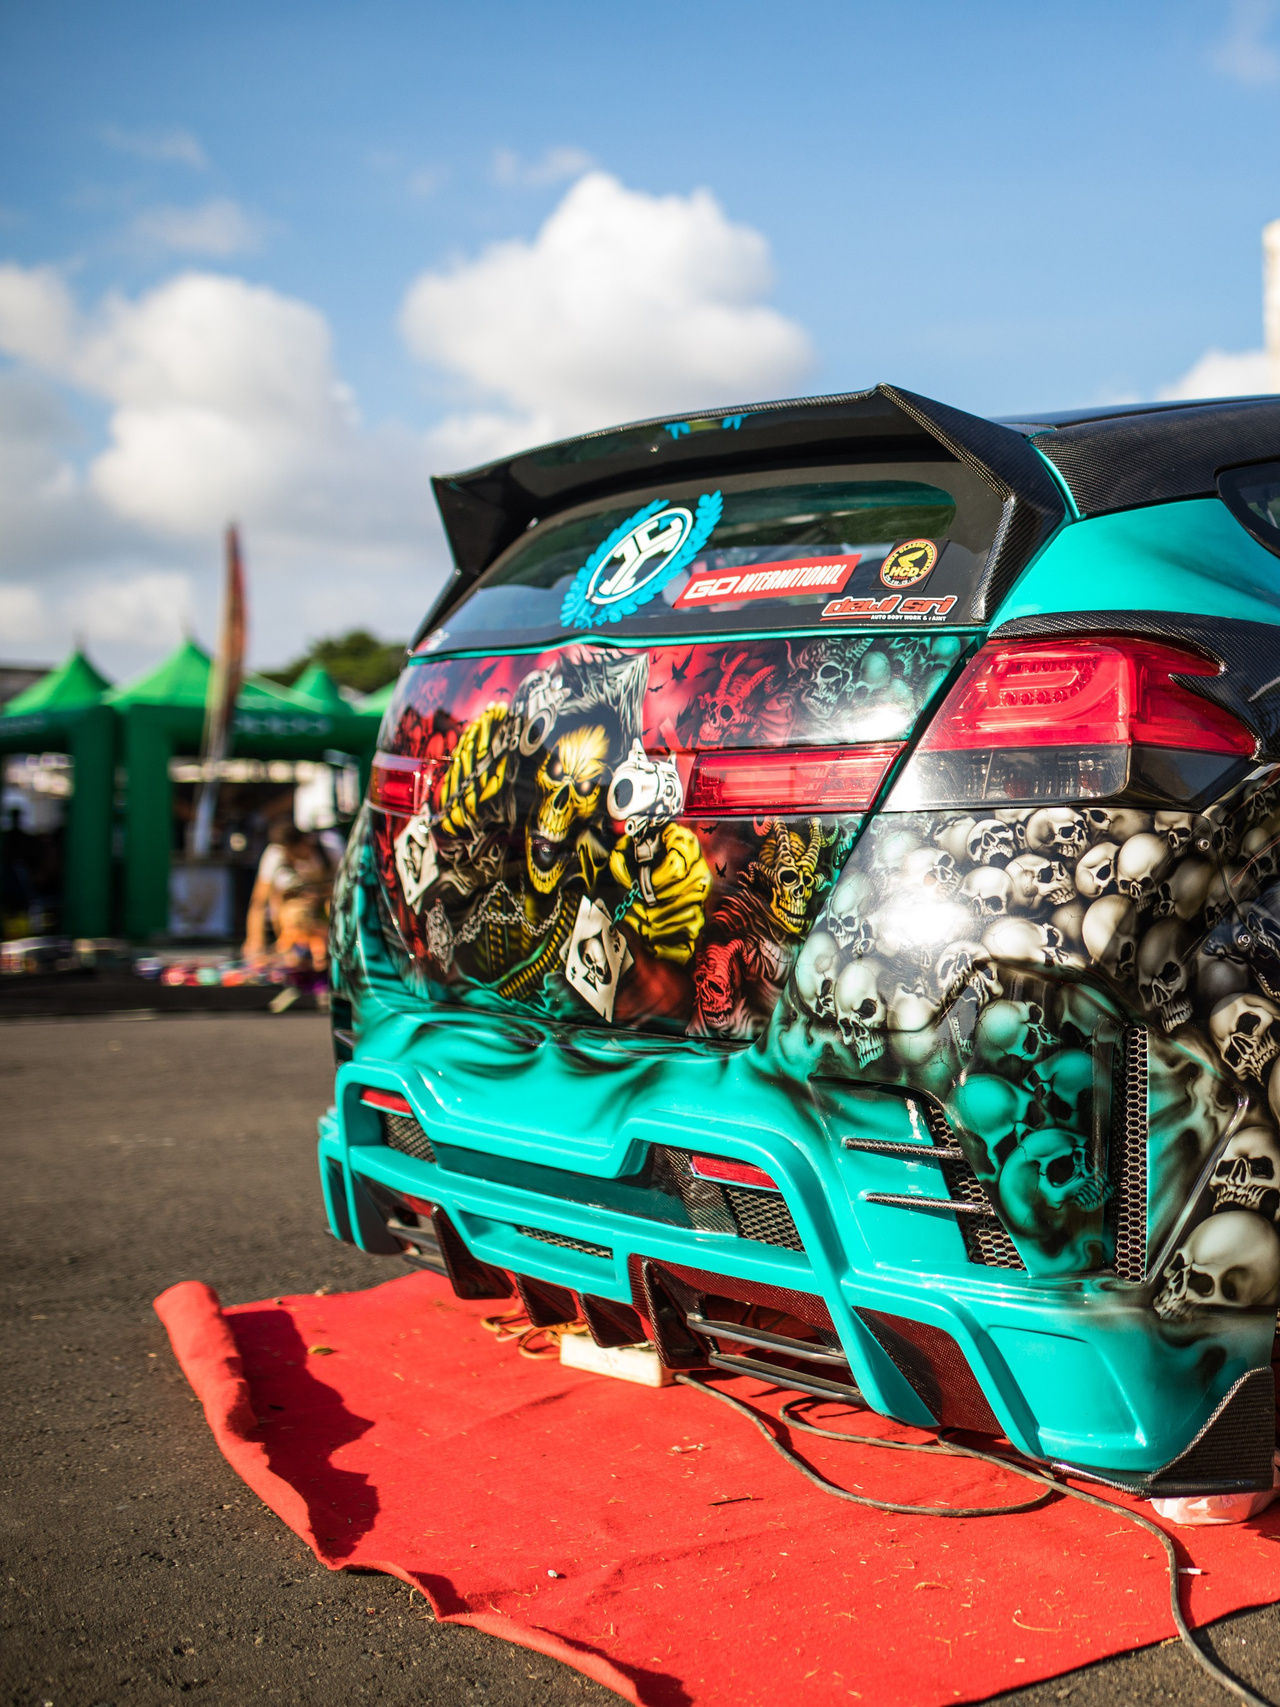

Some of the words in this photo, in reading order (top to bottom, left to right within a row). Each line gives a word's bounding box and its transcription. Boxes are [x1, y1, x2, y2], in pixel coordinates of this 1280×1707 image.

[684, 576, 741, 600] GO
[733, 563, 848, 594] INTERNATIONAL
[889, 566, 920, 577] HCD
